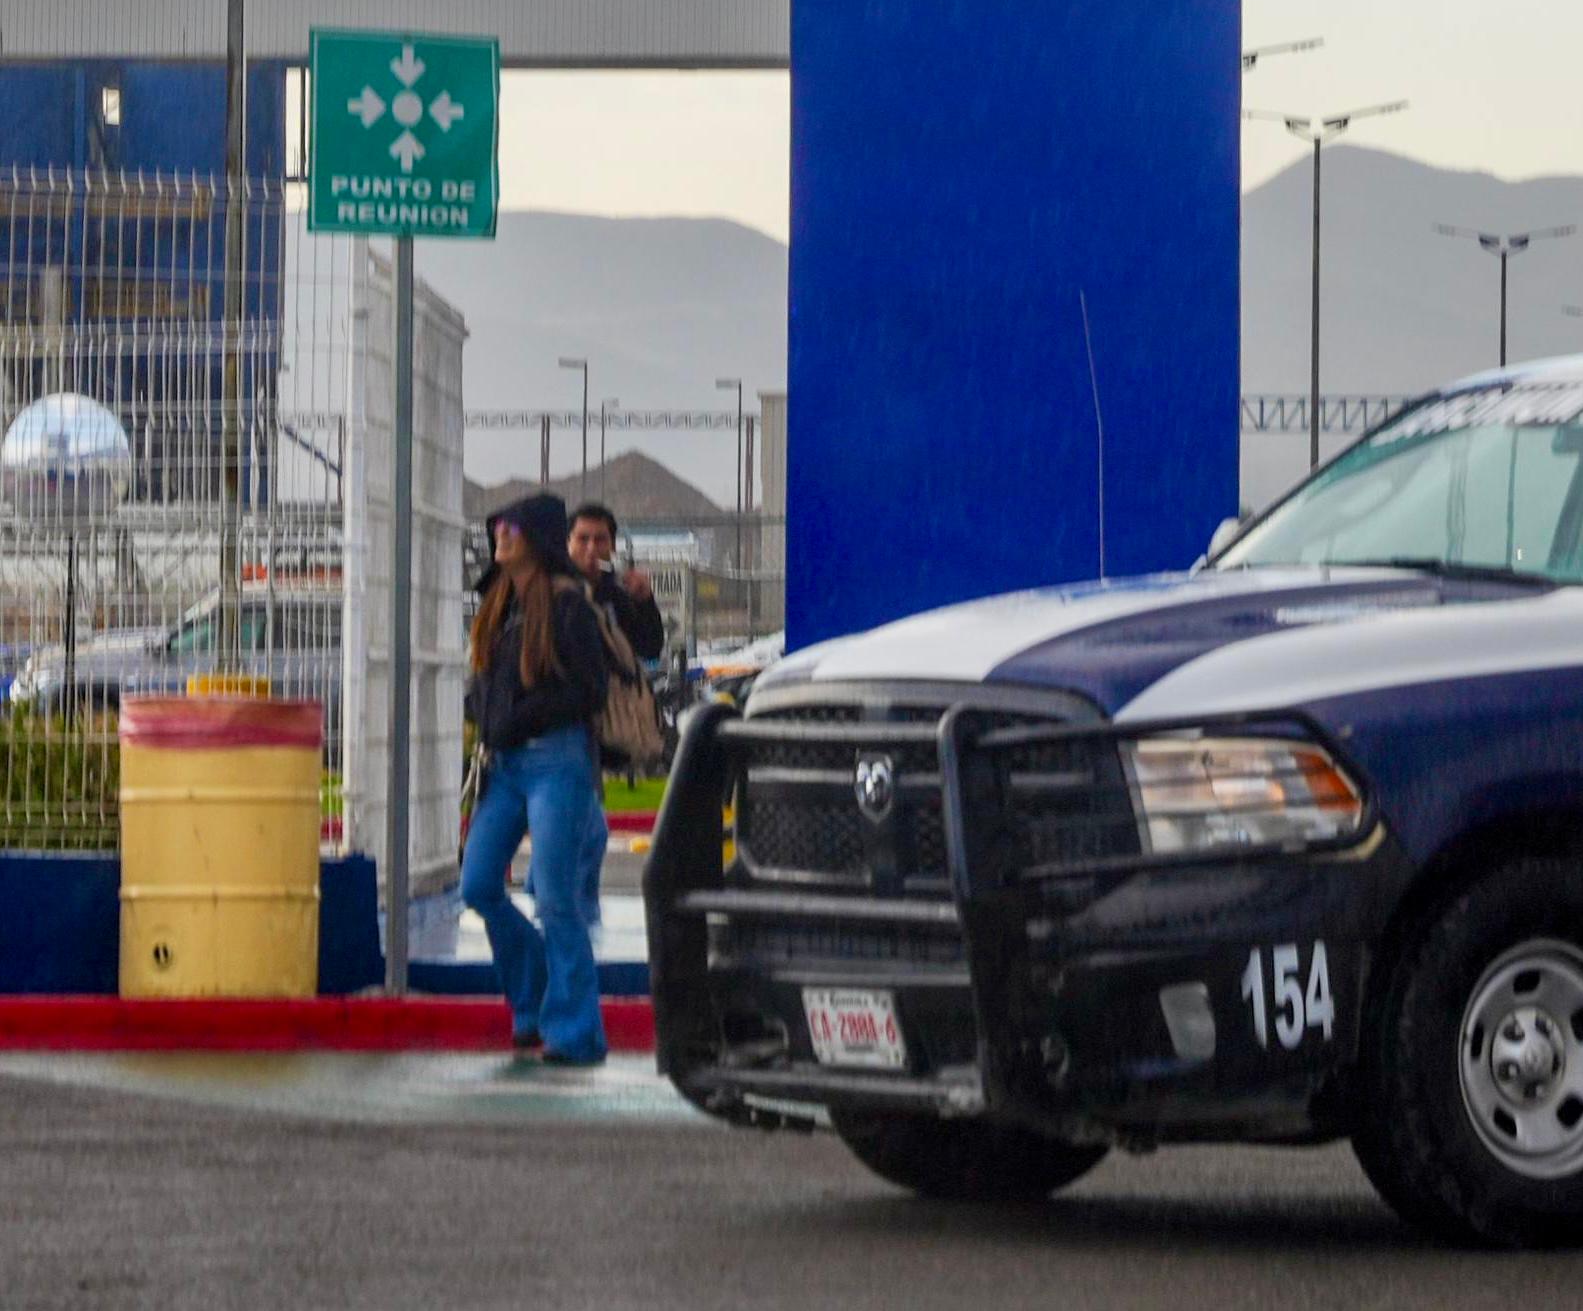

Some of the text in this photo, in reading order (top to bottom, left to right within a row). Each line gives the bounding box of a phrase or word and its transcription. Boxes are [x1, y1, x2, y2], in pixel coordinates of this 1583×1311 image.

[331, 175, 476, 203] PUNTO DE
[337, 200, 469, 227] REUNION
[1241, 939, 1335, 1050] 154
